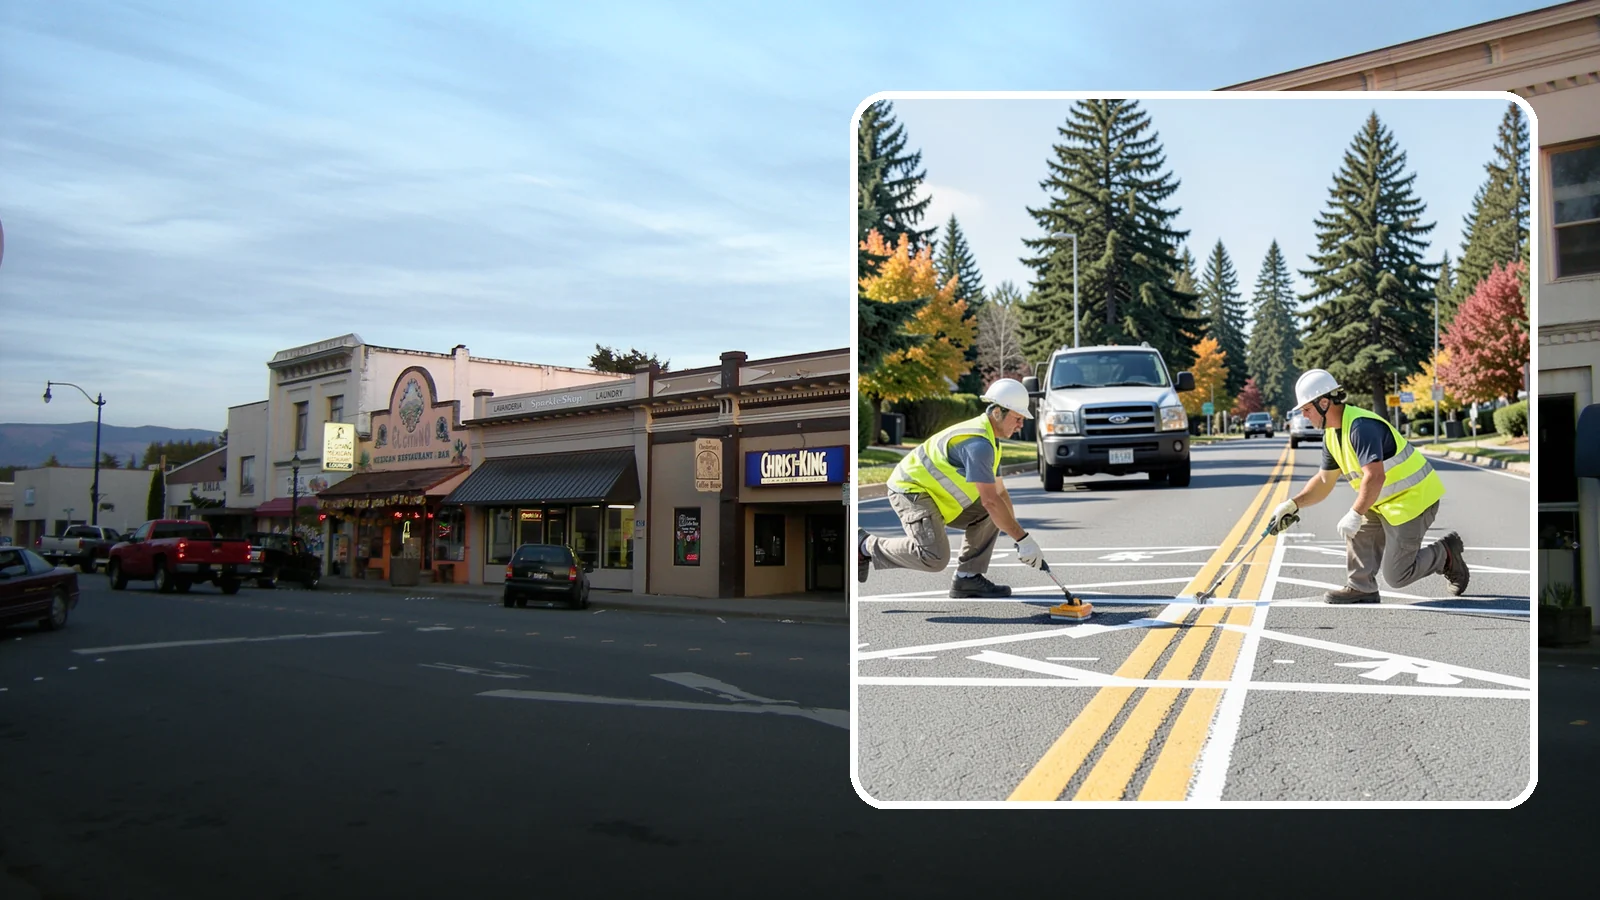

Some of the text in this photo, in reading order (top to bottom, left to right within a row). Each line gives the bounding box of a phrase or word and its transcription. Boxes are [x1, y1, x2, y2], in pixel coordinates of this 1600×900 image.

[561, 394, 583, 405] Shop
[595, 389, 624, 400] LAUNDRY
[493, 402, 522, 413] LAVANDERIA
[374, 450, 450, 464] MEXICAN RESTAURANT BAR
[761, 450, 827, 478] CHRIST KING
[696, 481, 722, 489] Coffee House
